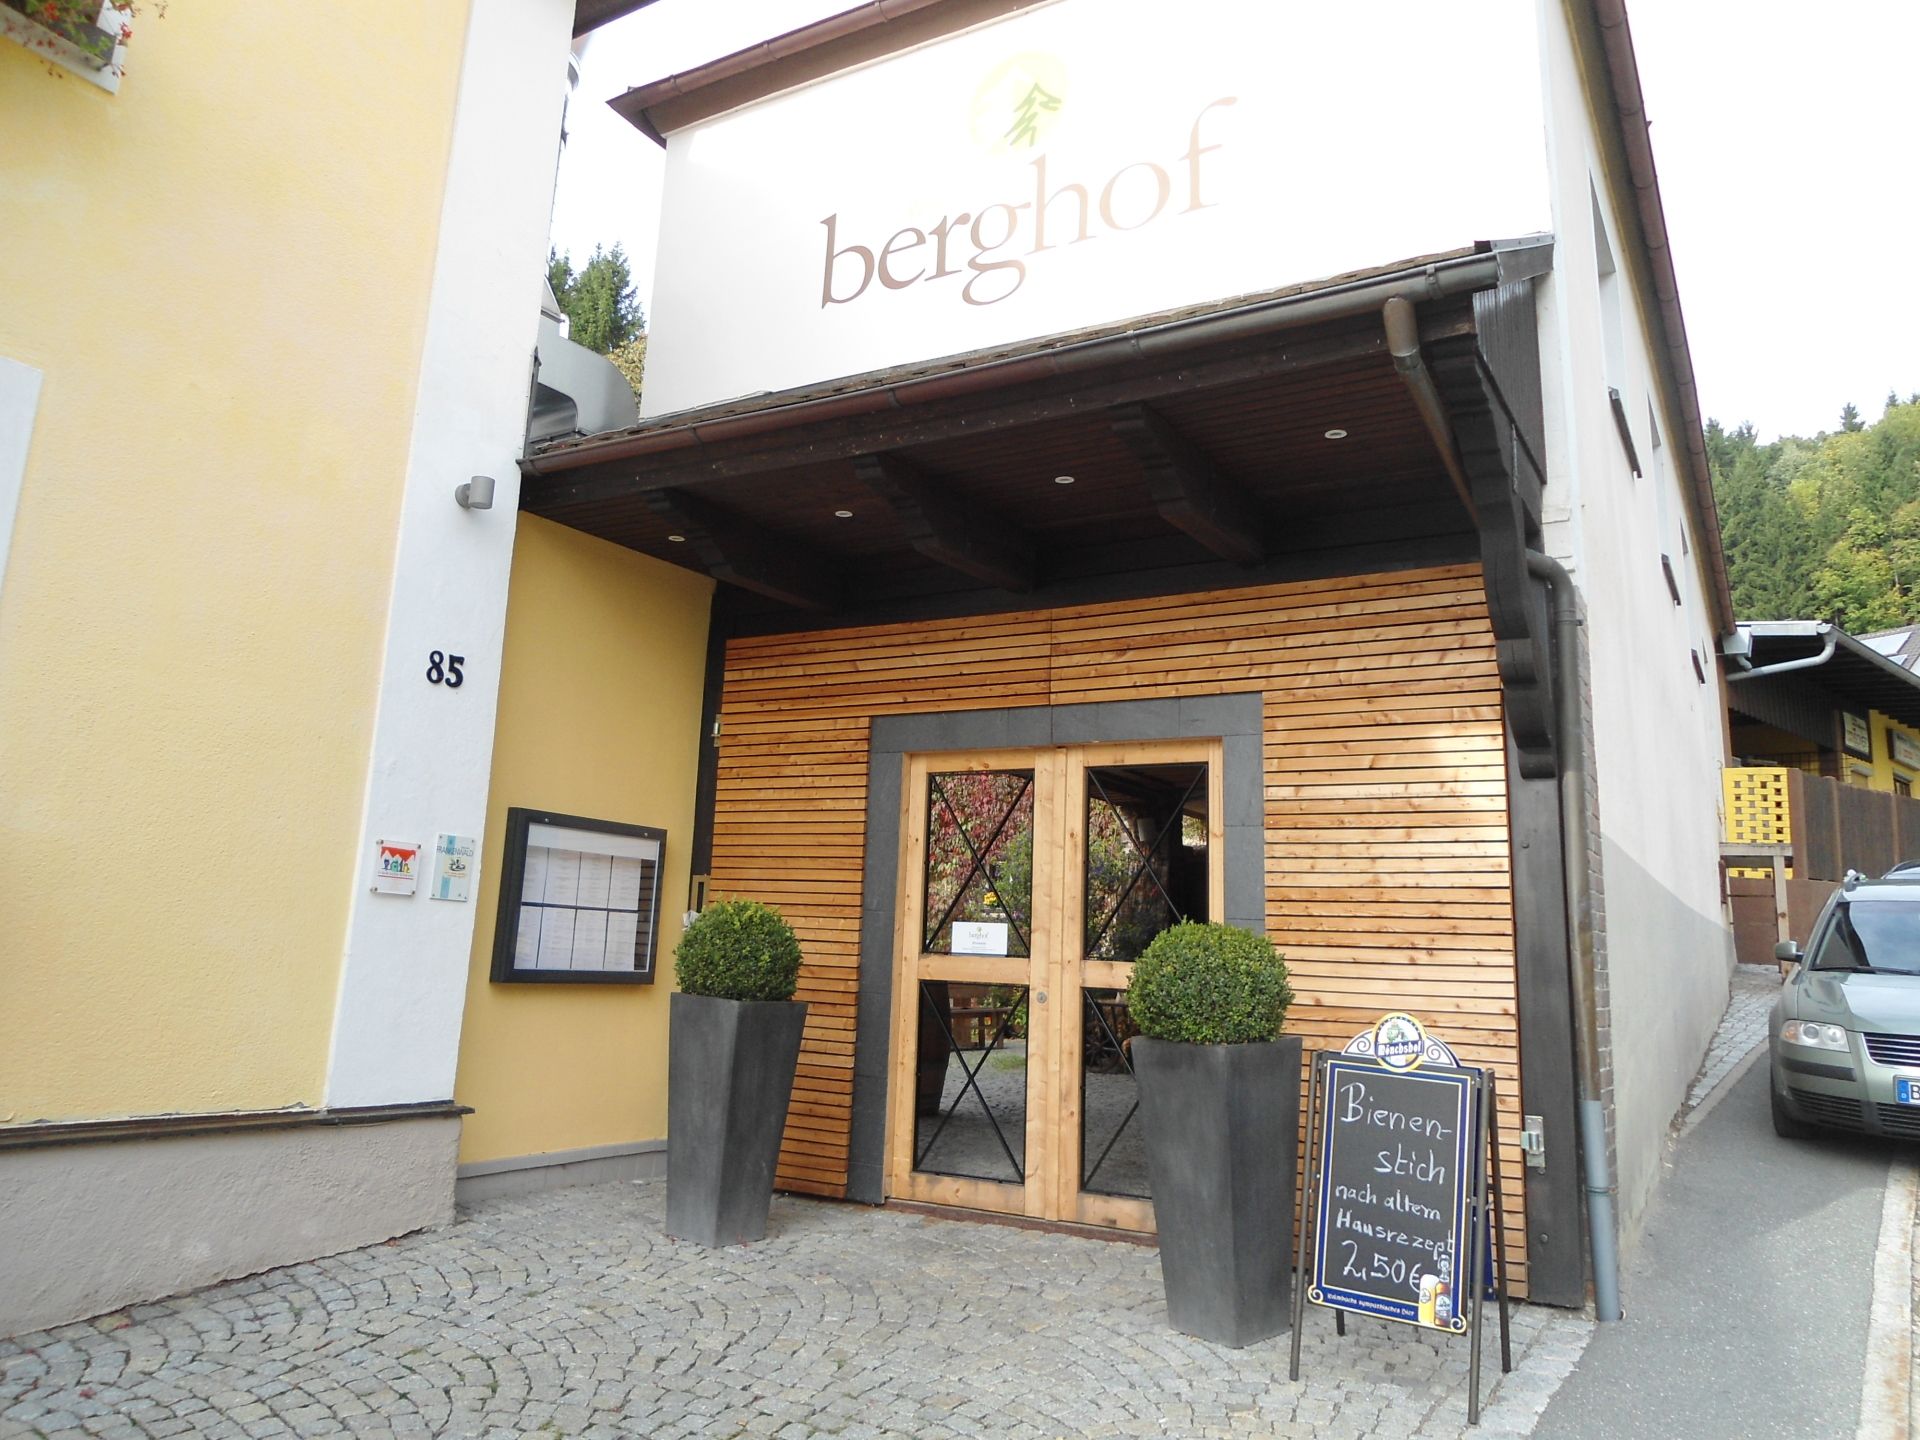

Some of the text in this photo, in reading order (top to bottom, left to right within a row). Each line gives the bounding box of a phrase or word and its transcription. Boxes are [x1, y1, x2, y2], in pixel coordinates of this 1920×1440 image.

[820, 96, 1238, 309] berghof
[426, 650, 465, 688] 85
[1335, 1184, 1440, 1220] nach altem
[1336, 1208, 1454, 1260] Hausrezept
